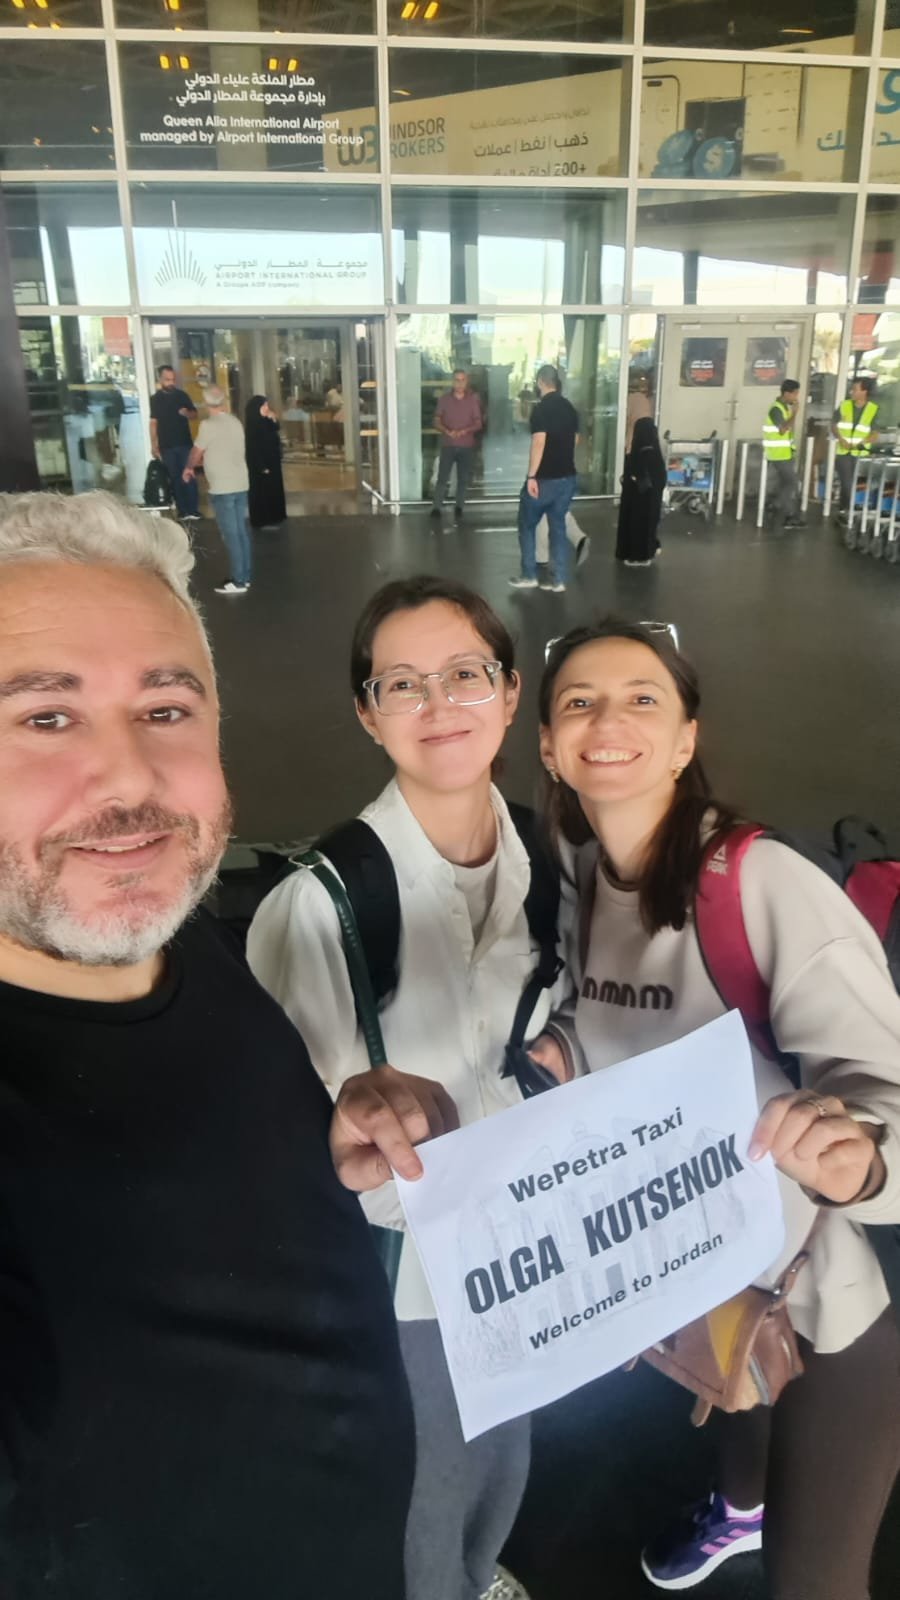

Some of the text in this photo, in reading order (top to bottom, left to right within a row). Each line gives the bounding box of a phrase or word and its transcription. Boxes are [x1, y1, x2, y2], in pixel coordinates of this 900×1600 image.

[185, 73, 316, 90] مطار الملكة علياء الدولي
[175, 90, 326, 107] بإدارة مجموعة المطار الدولي
[163, 115, 340, 131] Queen Alia International Airport
[389, 117, 446, 140] INDSOR
[140, 131, 364, 146] managed by Airport International Group
[389, 137, 446, 159] ROKERS
[473, 131, 590, 158] ذهب نفط عملات
[215, 271, 367, 279] AIRPORT INTERNATIONAL GROUP
[507, 1106, 684, 1203] WePetra Taxi
[464, 1133, 744, 1314] OLGA KUTSENOK
[530, 1234, 724, 1350] Welcome to Jordan
